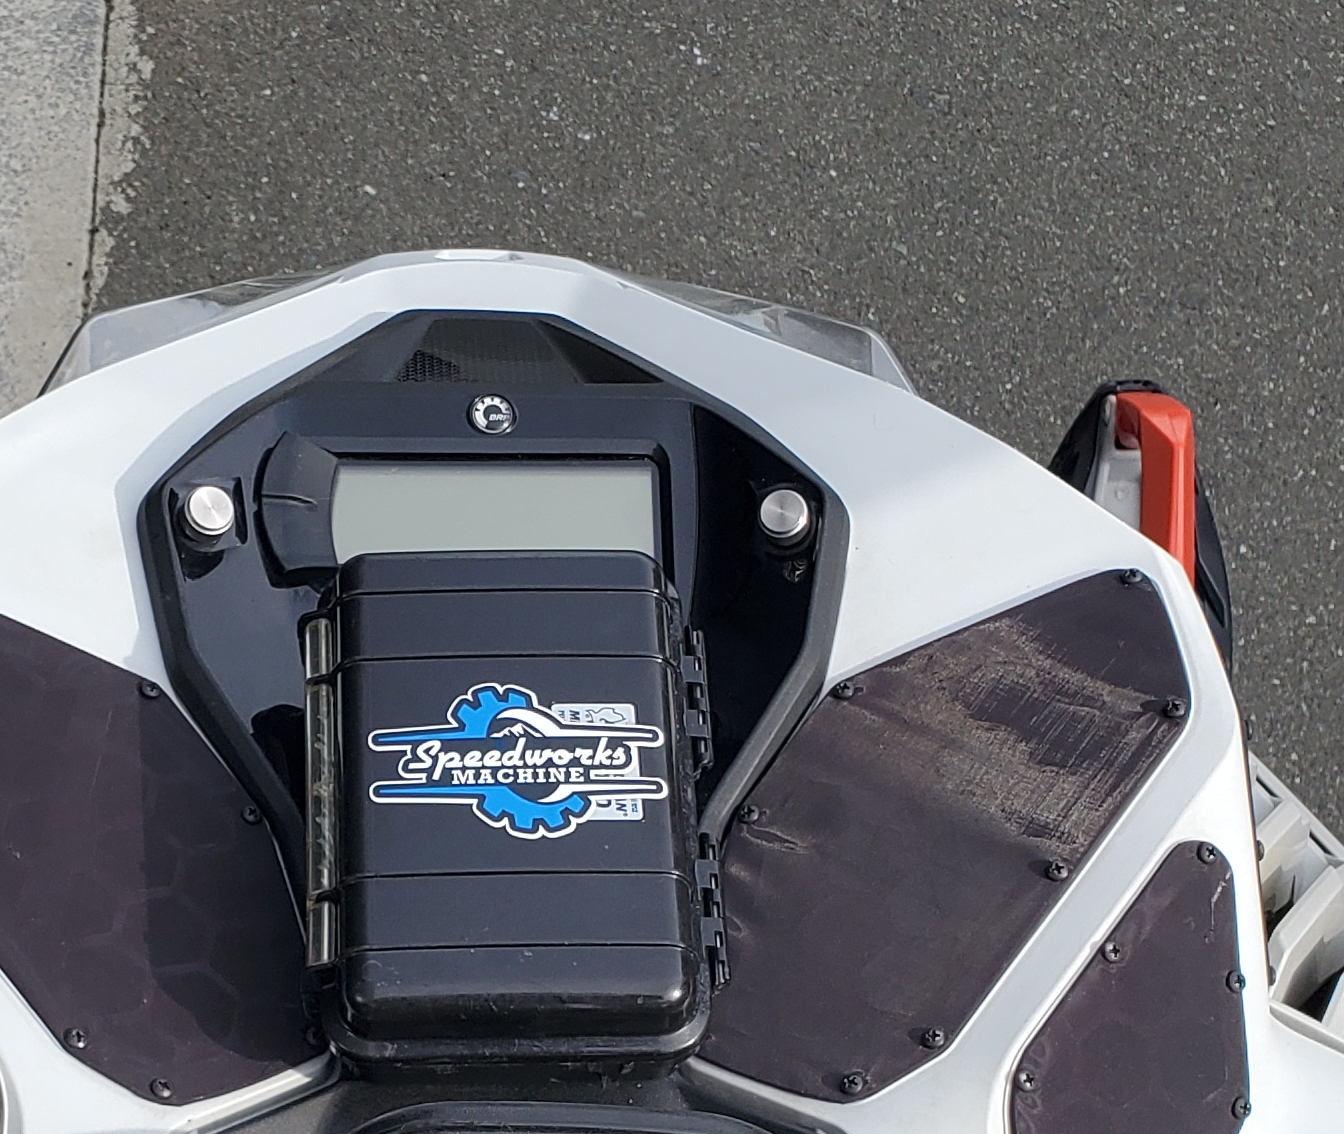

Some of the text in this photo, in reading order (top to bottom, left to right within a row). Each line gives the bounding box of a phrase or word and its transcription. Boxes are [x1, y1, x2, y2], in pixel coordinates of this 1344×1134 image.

[489, 413, 511, 421] BRP
[408, 736, 627, 782] Speedworks
[451, 767, 585, 785] MACHINE
